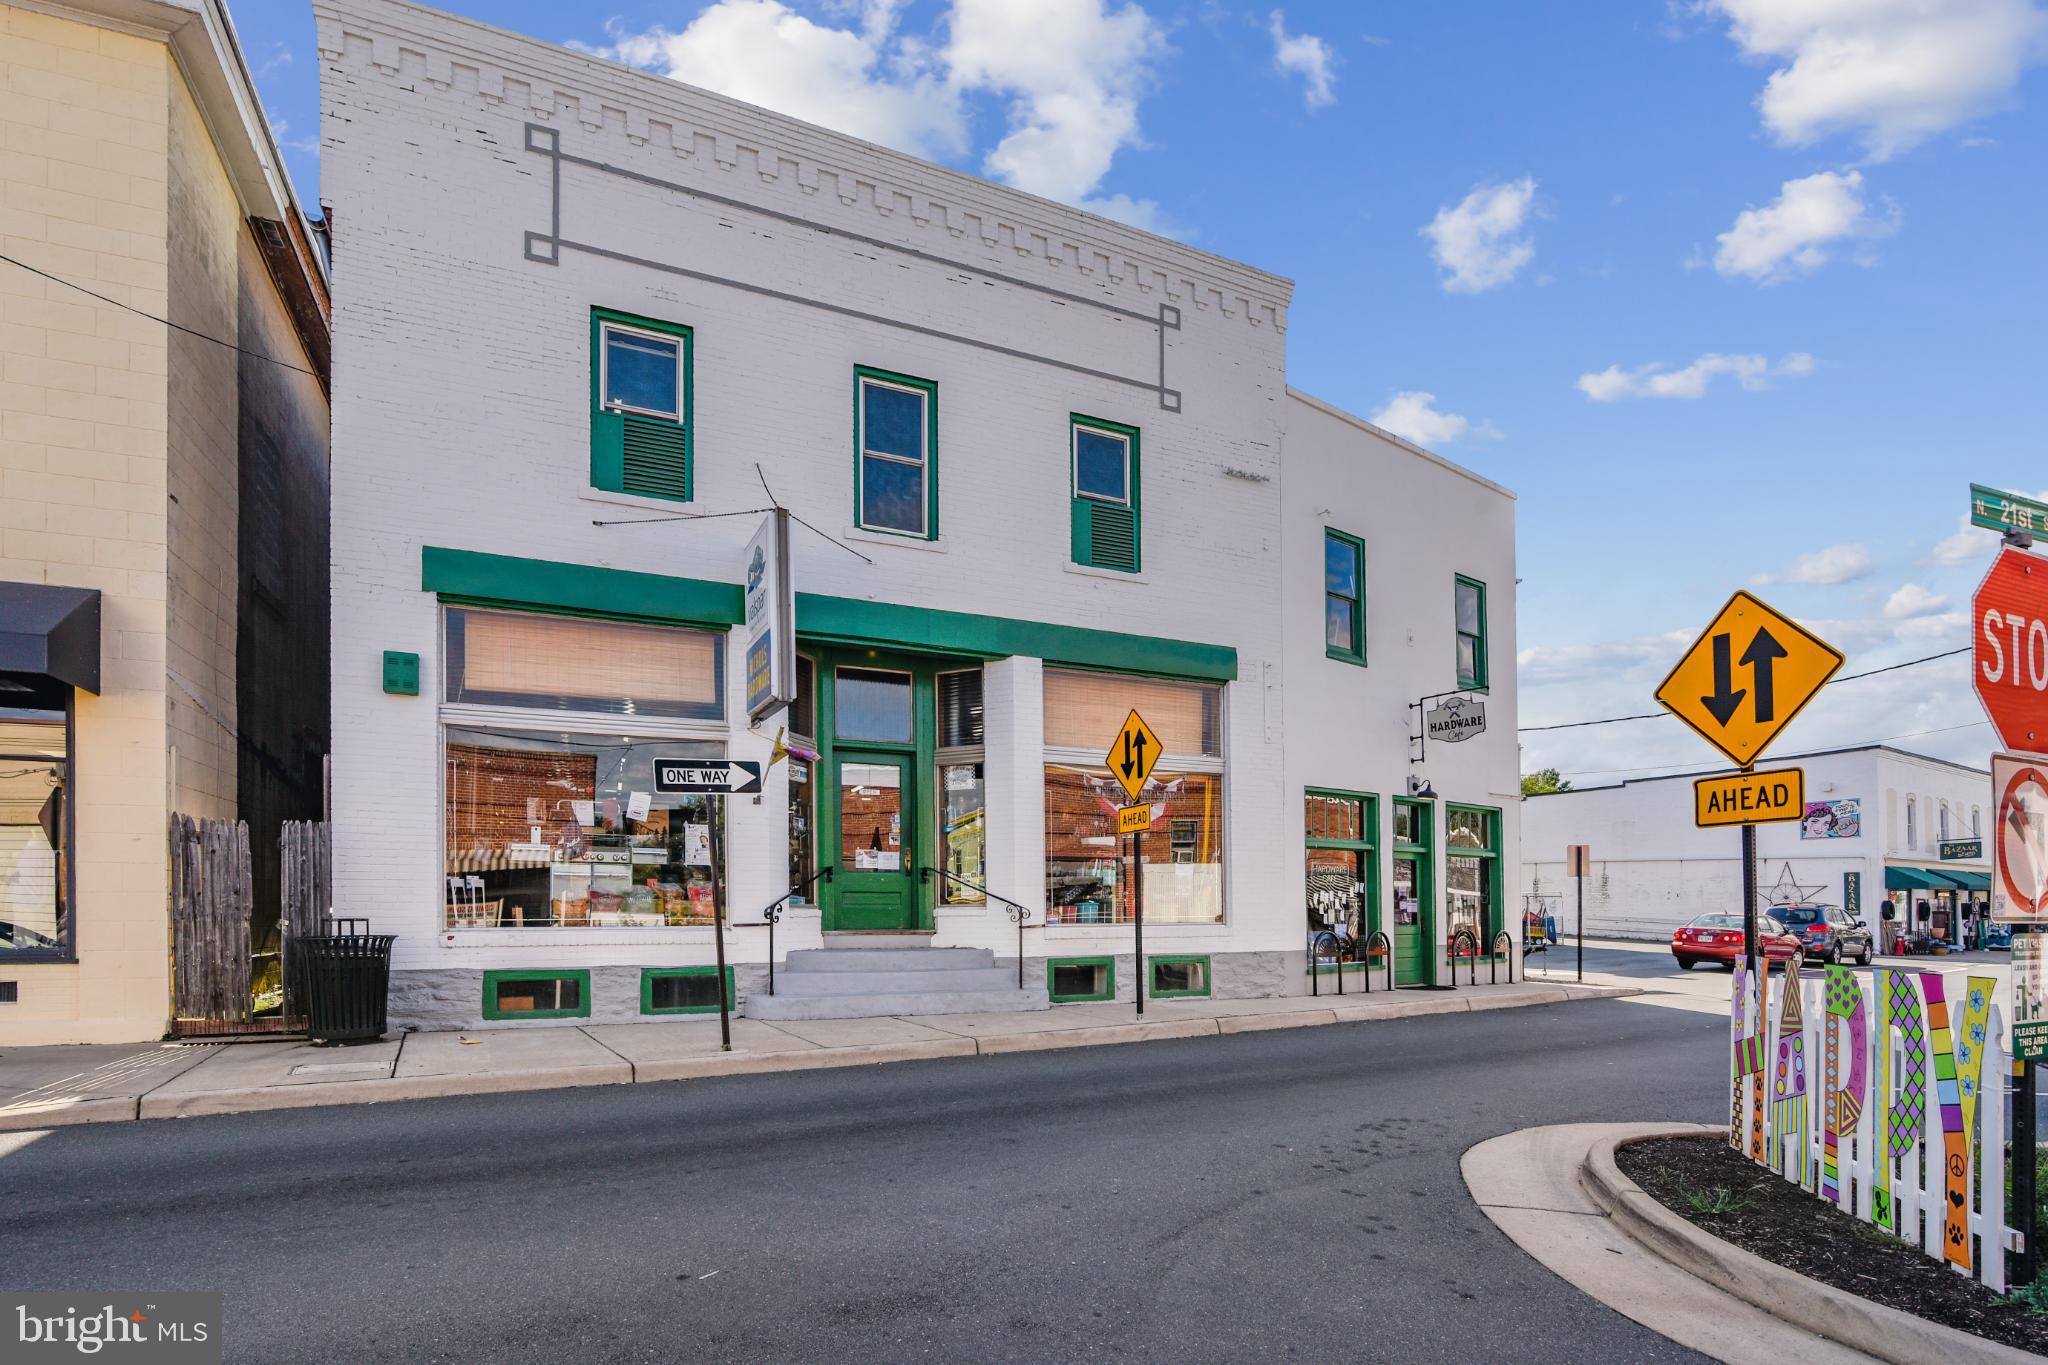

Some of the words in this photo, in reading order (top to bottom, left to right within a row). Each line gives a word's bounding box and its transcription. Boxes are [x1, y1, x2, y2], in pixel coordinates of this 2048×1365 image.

[1976, 498, 1988, 517] N.
[2000, 500, 2032, 530] 21st
[1982, 608, 2048, 692] STO
[1430, 715, 1483, 732] HARDWARE
[667, 769, 696, 783] ONE
[700, 770, 730, 784] WAY
[1708, 783, 1790, 814] AHEAD
[1123, 811, 1147, 826] AHEAD
[1943, 845, 1978, 856] BAZAAR
[1848, 875, 1857, 911] BAZAAR
[2013, 938, 2027, 950] PET
[2014, 1026, 2037, 1037] PLEASE
[2018, 1037, 2033, 1047] THIS
[2033, 1036, 2048, 1045] AREA
